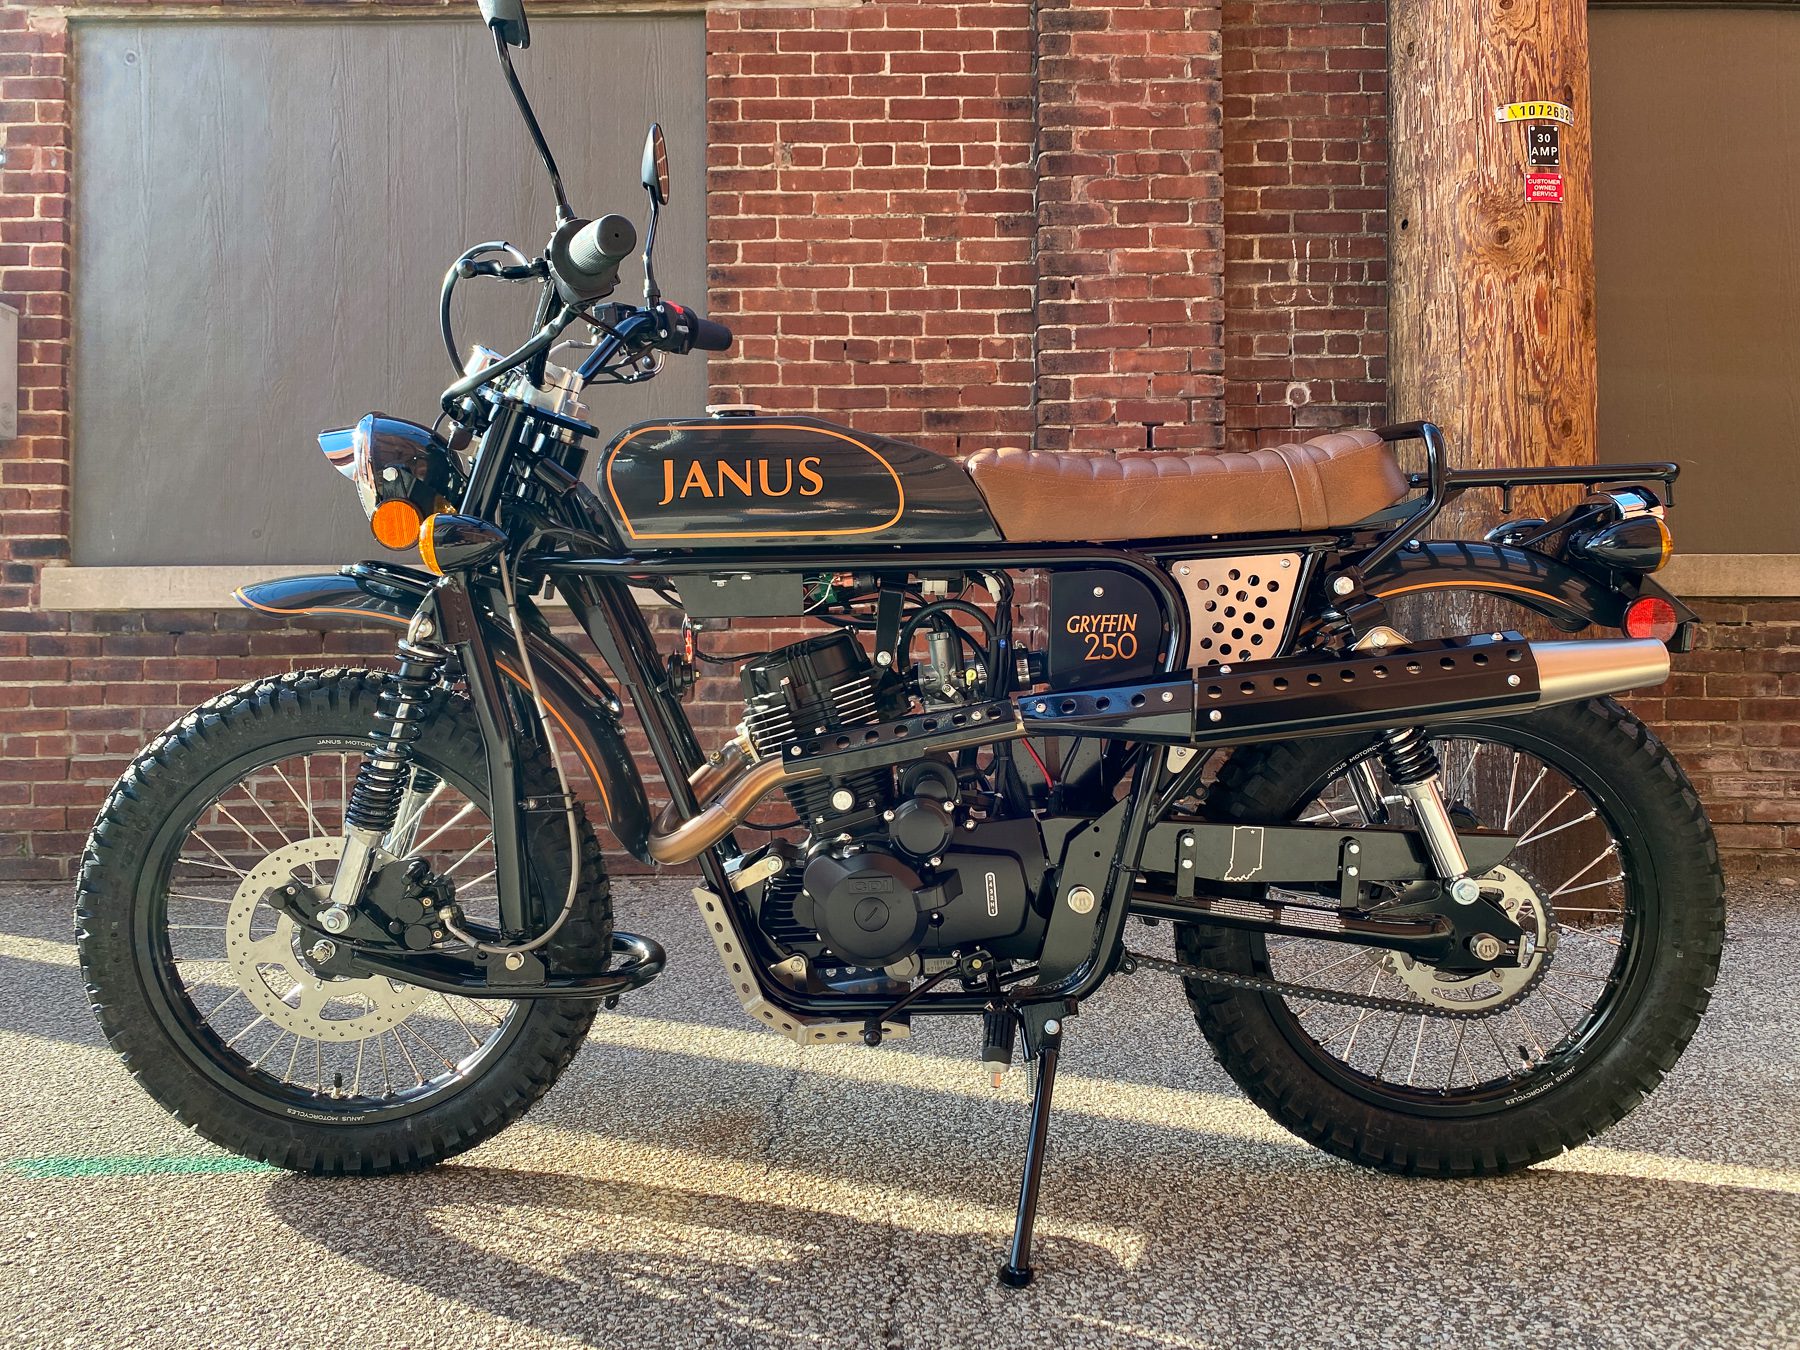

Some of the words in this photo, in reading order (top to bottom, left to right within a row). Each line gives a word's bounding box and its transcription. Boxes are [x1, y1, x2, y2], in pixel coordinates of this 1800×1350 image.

[1537, 133, 1551, 143] 30
[1531, 146, 1558, 156] AMP
[658, 456, 824, 506] JANUS
[1066, 613, 1138, 634] GRYFFIN
[1084, 632, 1138, 660] 250
[1326, 762, 1348, 779] JANUS
[1555, 1065, 1576, 1083] JANUS
[1504, 1081, 1554, 1105] MOTORCYCLES
[286, 1107, 339, 1121] MOTORCYCLES
